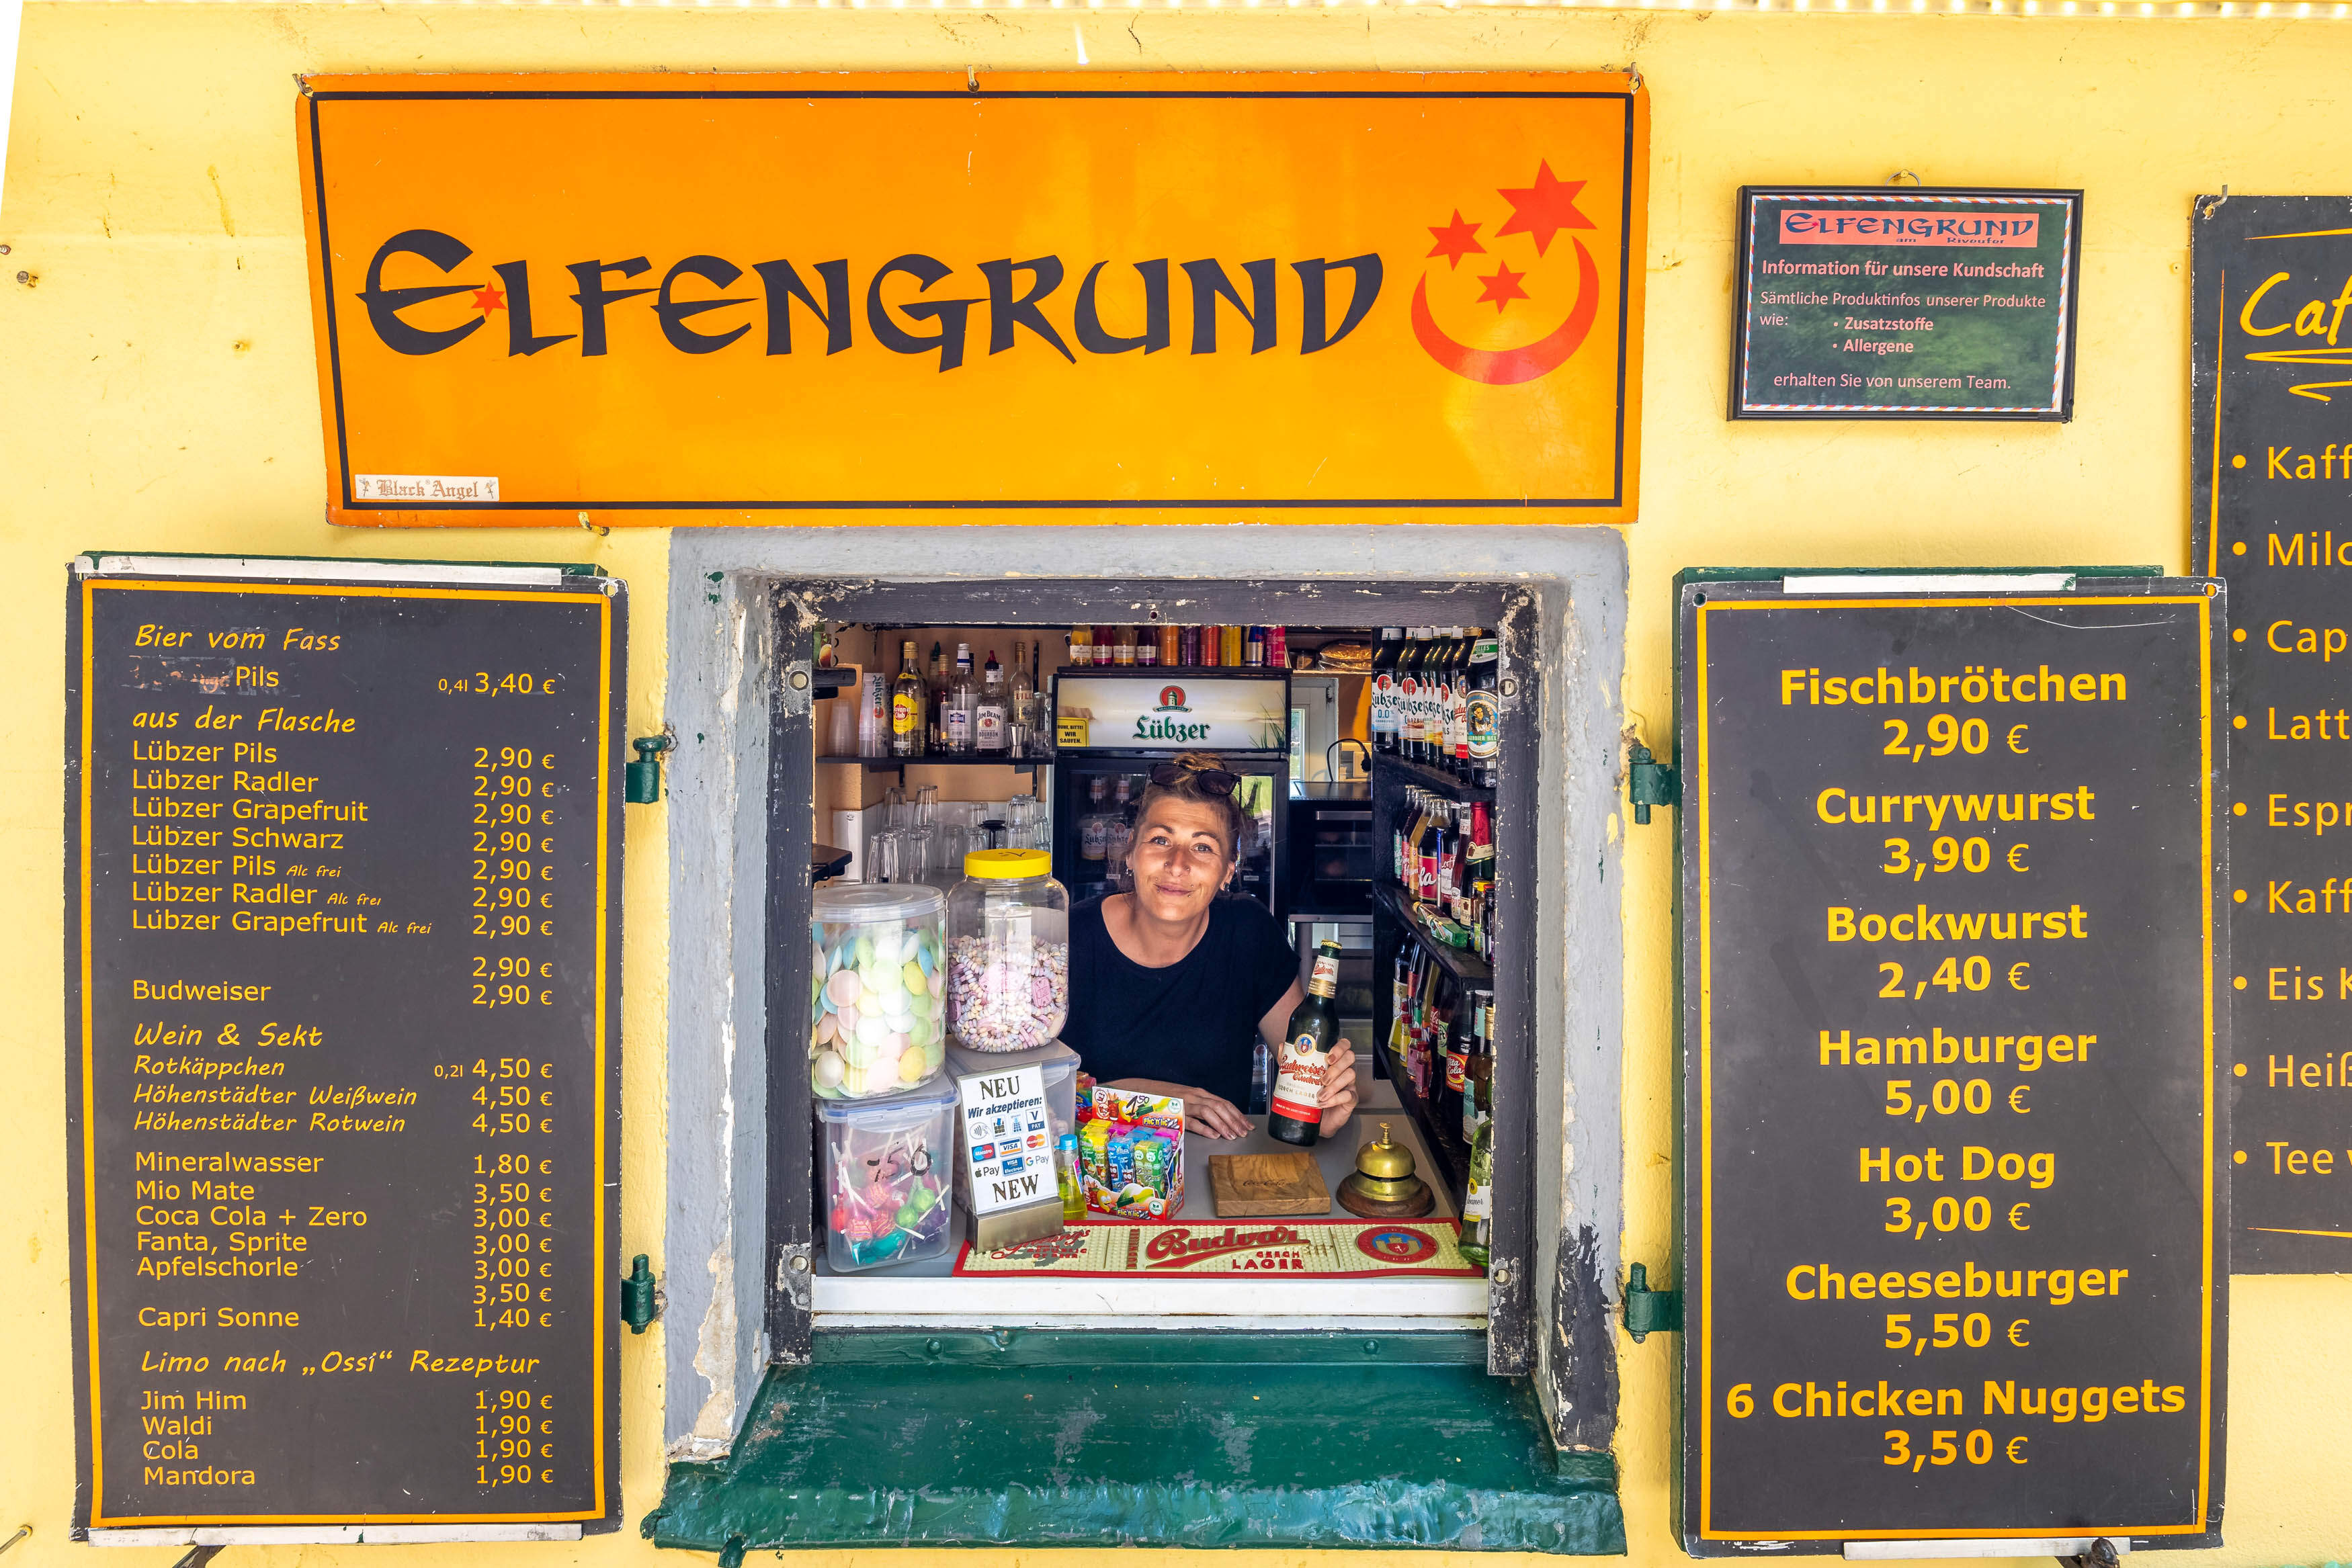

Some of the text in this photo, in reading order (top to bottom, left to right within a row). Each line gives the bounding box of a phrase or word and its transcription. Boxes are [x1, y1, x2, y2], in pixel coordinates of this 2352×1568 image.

[1763, 259, 2044, 278] Information für unsere Kundschaft
[1760, 292, 2046, 308] Sämtliche Produktinfos unserer Produkte
[1759, 314, 1934, 331] wie: Zusatzstoffe
[1843, 339, 1914, 355] Allergene
[1774, 373, 2011, 389] erhalten Sie von unserem Team.
[2269, 443, 2352, 479] Kaff
[377, 480, 478, 500] Black Angel
[135, 624, 339, 650] Bier vom Fass
[2267, 620, 2347, 662] Cap
[237, 666, 279, 687] Pils
[475, 672, 532, 697] 3,40
[1781, 665, 2126, 705] Fischbrötchen
[133, 705, 355, 732] aus der Flasche
[978, 710, 1001, 721] JIM BEAM
[2269, 707, 2350, 740] Latt
[1132, 715, 1211, 742] Lübzer
[1884, 713, 1989, 763] 2,90
[134, 740, 532, 772] Lübzer Pils 2,90
[133, 769, 319, 792] Lübzer Radler
[133, 797, 368, 824] Lübzer Grapefruit
[1816, 786, 2095, 831] Currywurst
[133, 825, 343, 849] Lübzer Schwarz
[133, 853, 340, 877] Lübzer Pils Alc frei
[1884, 836, 1990, 881] 3,90
[133, 881, 381, 906] Lübzer Radler Alc frei
[2269, 877, 2352, 913] Kaff
[232, 911, 368, 936] Grapefruit
[377, 921, 398, 933] Alc
[407, 922, 430, 934] frei
[1828, 904, 2087, 942] Bockwurst
[134, 979, 271, 1001] Budweiser
[1879, 955, 1991, 1000] 2,40
[2269, 966, 2324, 1000] Eis
[134, 1021, 323, 1047] Wein & Sekt
[1820, 1027, 2097, 1072] Hamburger
[134, 1055, 284, 1080] Rotkäppchen
[134, 1083, 417, 1109] Höhenstädter Weißwein
[979, 1076, 1020, 1100] NEU
[1886, 1078, 1992, 1123] 5,00
[968, 1096, 1042, 1119] Wir akzeptieren:
[1031, 1110, 1039, 1121] V
[134, 1110, 405, 1132] Höhenstädter Rotwein
[974, 1148, 993, 1156] Maestro
[1003, 1143, 1019, 1151] VISA
[2265, 1141, 2333, 1174] Tee
[136, 1151, 324, 1172] Mineralwasser
[983, 1166, 1001, 1177] Pay
[1004, 1166, 1023, 1174] Electron
[1035, 1156, 1050, 1165] Pay
[1860, 1146, 2054, 1189] Hot Dog
[136, 1180, 254, 1201] Mio Mate
[992, 1174, 1039, 1203] NEW
[136, 1205, 367, 1226] Coca Cola + Zero
[1886, 1196, 1991, 1239] 3,00
[138, 1231, 306, 1256] Fanta, Sprite
[1145, 1227, 1310, 1266] Budvar
[136, 1256, 298, 1280] Apfelschorle
[1232, 1258, 1304, 1270] LAGER
[1786, 1262, 2129, 1305] Cheeseburger
[138, 1307, 299, 1332] Capri Sonne
[1886, 1313, 1991, 1356] 5,50
[141, 1350, 209, 1373] Limo
[224, 1350, 286, 1373] nach
[410, 1350, 540, 1378] Rezeptur
[140, 1390, 530, 1413] Jim Him 1,90
[1727, 1379, 2185, 1423] 6 Chicken Nuggets
[142, 1415, 212, 1435] Waldi
[143, 1440, 198, 1460] Cola
[1884, 1429, 1993, 1473] 3,50
[144, 1465, 255, 1485] Mandora
